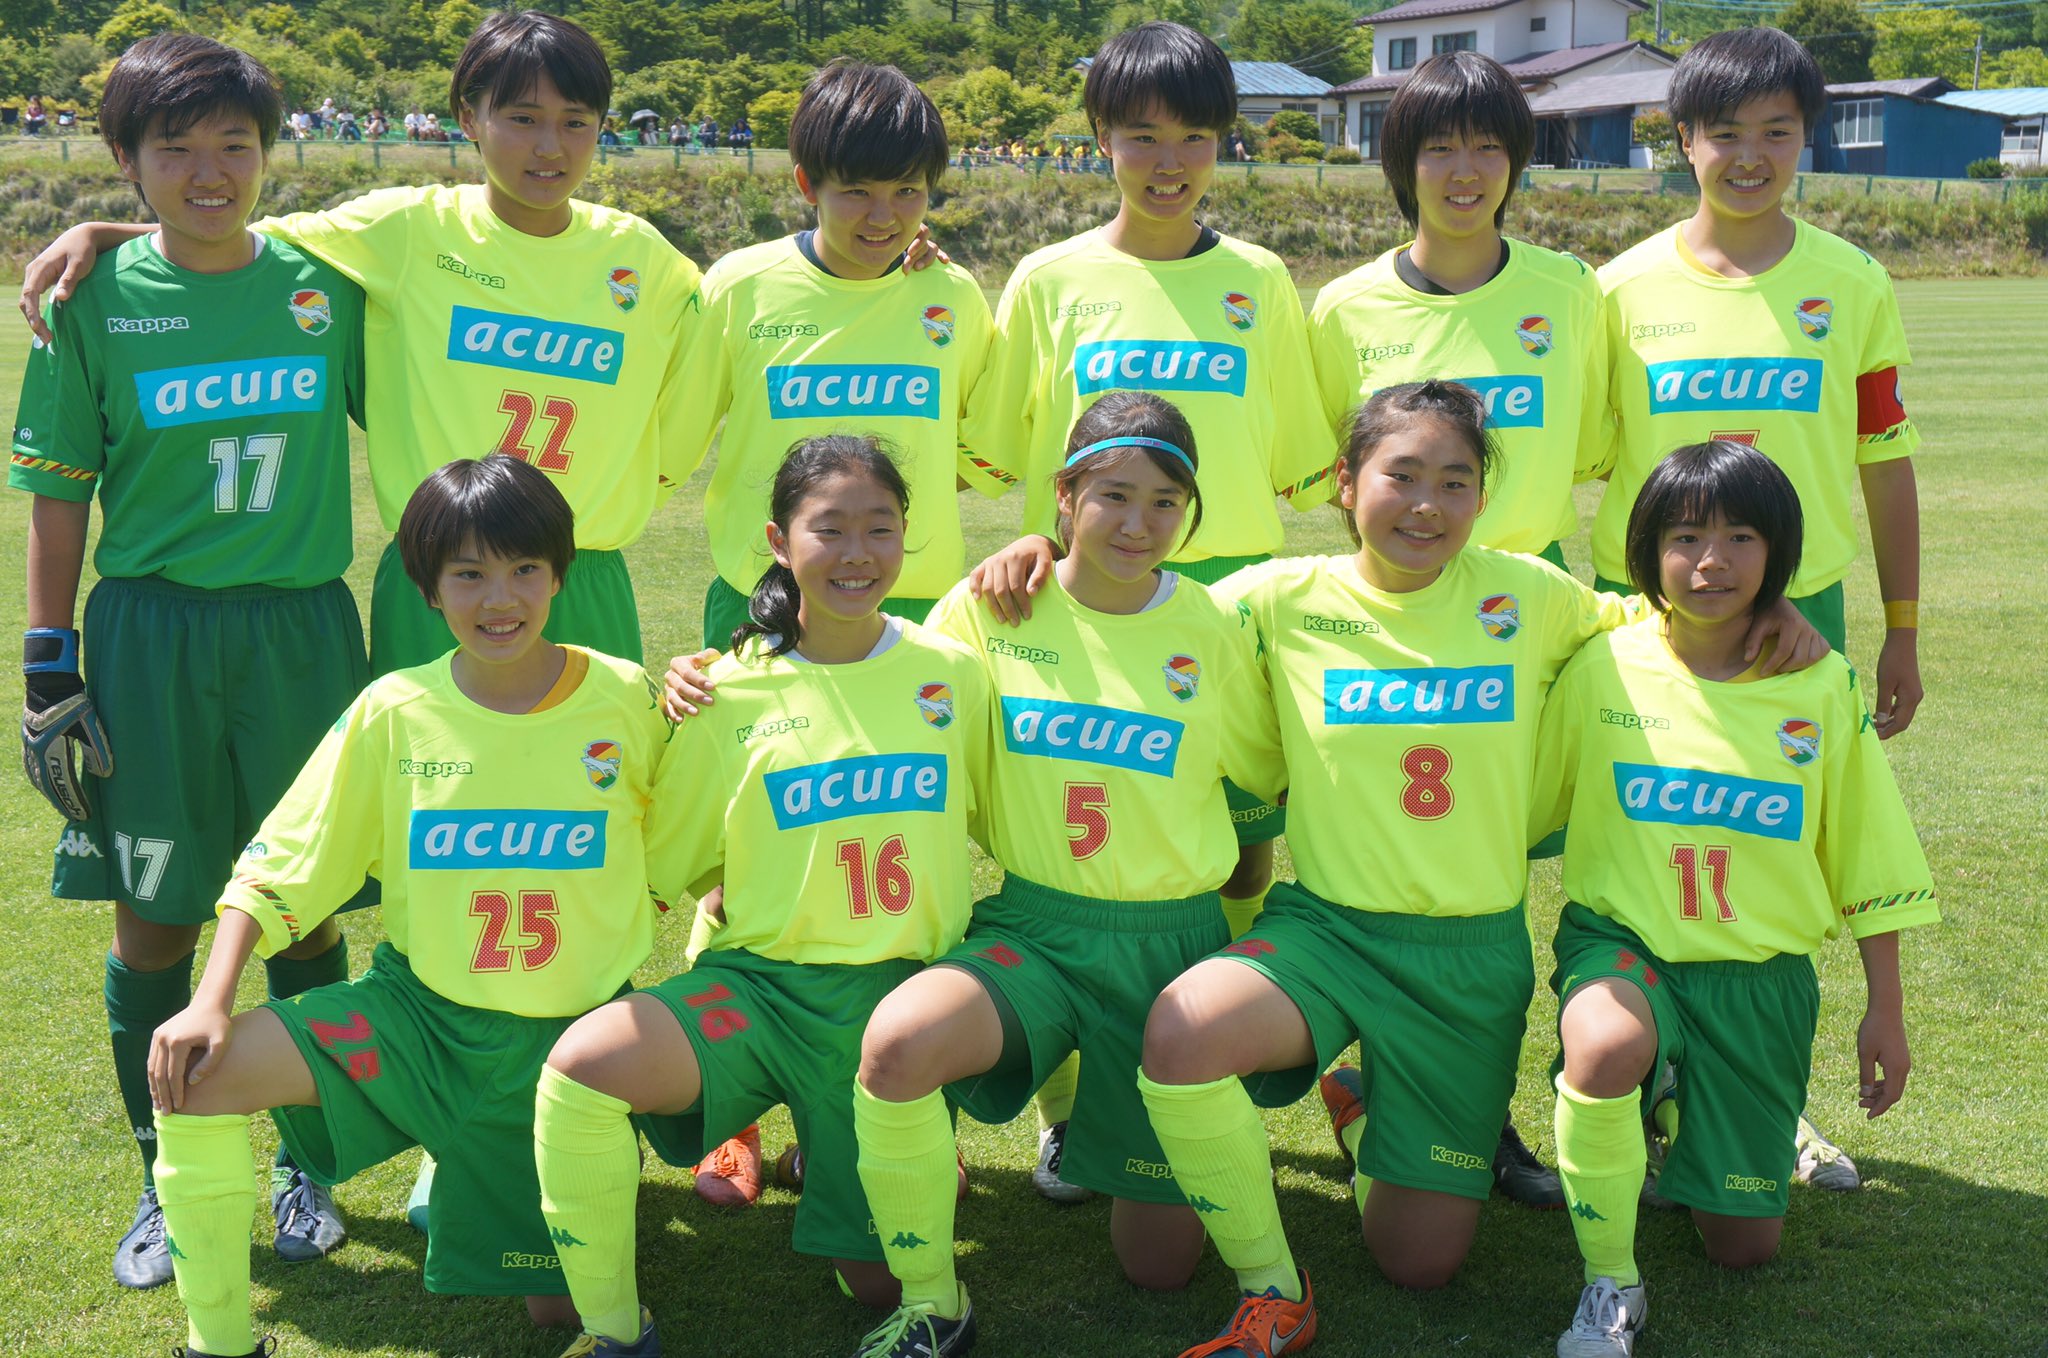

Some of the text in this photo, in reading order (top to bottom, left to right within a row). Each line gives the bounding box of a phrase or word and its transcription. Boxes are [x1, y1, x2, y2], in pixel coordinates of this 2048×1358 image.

[107, 316, 189, 333] Kappa
[1056, 300, 1122, 318] Kappa
[464, 321, 616, 373] acure
[749, 322, 819, 339] Kappa
[1632, 321, 1695, 340] Kappa
[1087, 348, 1236, 381] acure
[155, 366, 318, 414] acure
[781, 372, 931, 407] acure
[1656, 368, 1809, 402] acure
[497, 389, 578, 474] 22
[208, 433, 288, 514] 17
[1303, 614, 1380, 635] Kappa
[987, 637, 1060, 665] Kappa
[1339, 676, 1504, 712] acure
[737, 715, 809, 744] Kappa
[1012, 707, 1173, 762] acure
[1600, 708, 1670, 731] Kappa
[398, 759, 473, 777] Kappa
[1399, 744, 1455, 821] 8
[783, 765, 938, 816] acure
[1625, 776, 1790, 827] acure
[424, 820, 596, 857] acure
[1063, 781, 1111, 862] 5
[115, 831, 174, 901] 17
[836, 834, 914, 920] 16
[1669, 843, 1739, 923] 11
[469, 890, 561, 974] 25
[680, 981, 752, 1044] 16
[1125, 1158, 1174, 1179] Kap
[1431, 1145, 1488, 1170] Kappa
[1725, 1174, 1777, 1192] Kappa
[502, 1252, 561, 1269] Kapp
